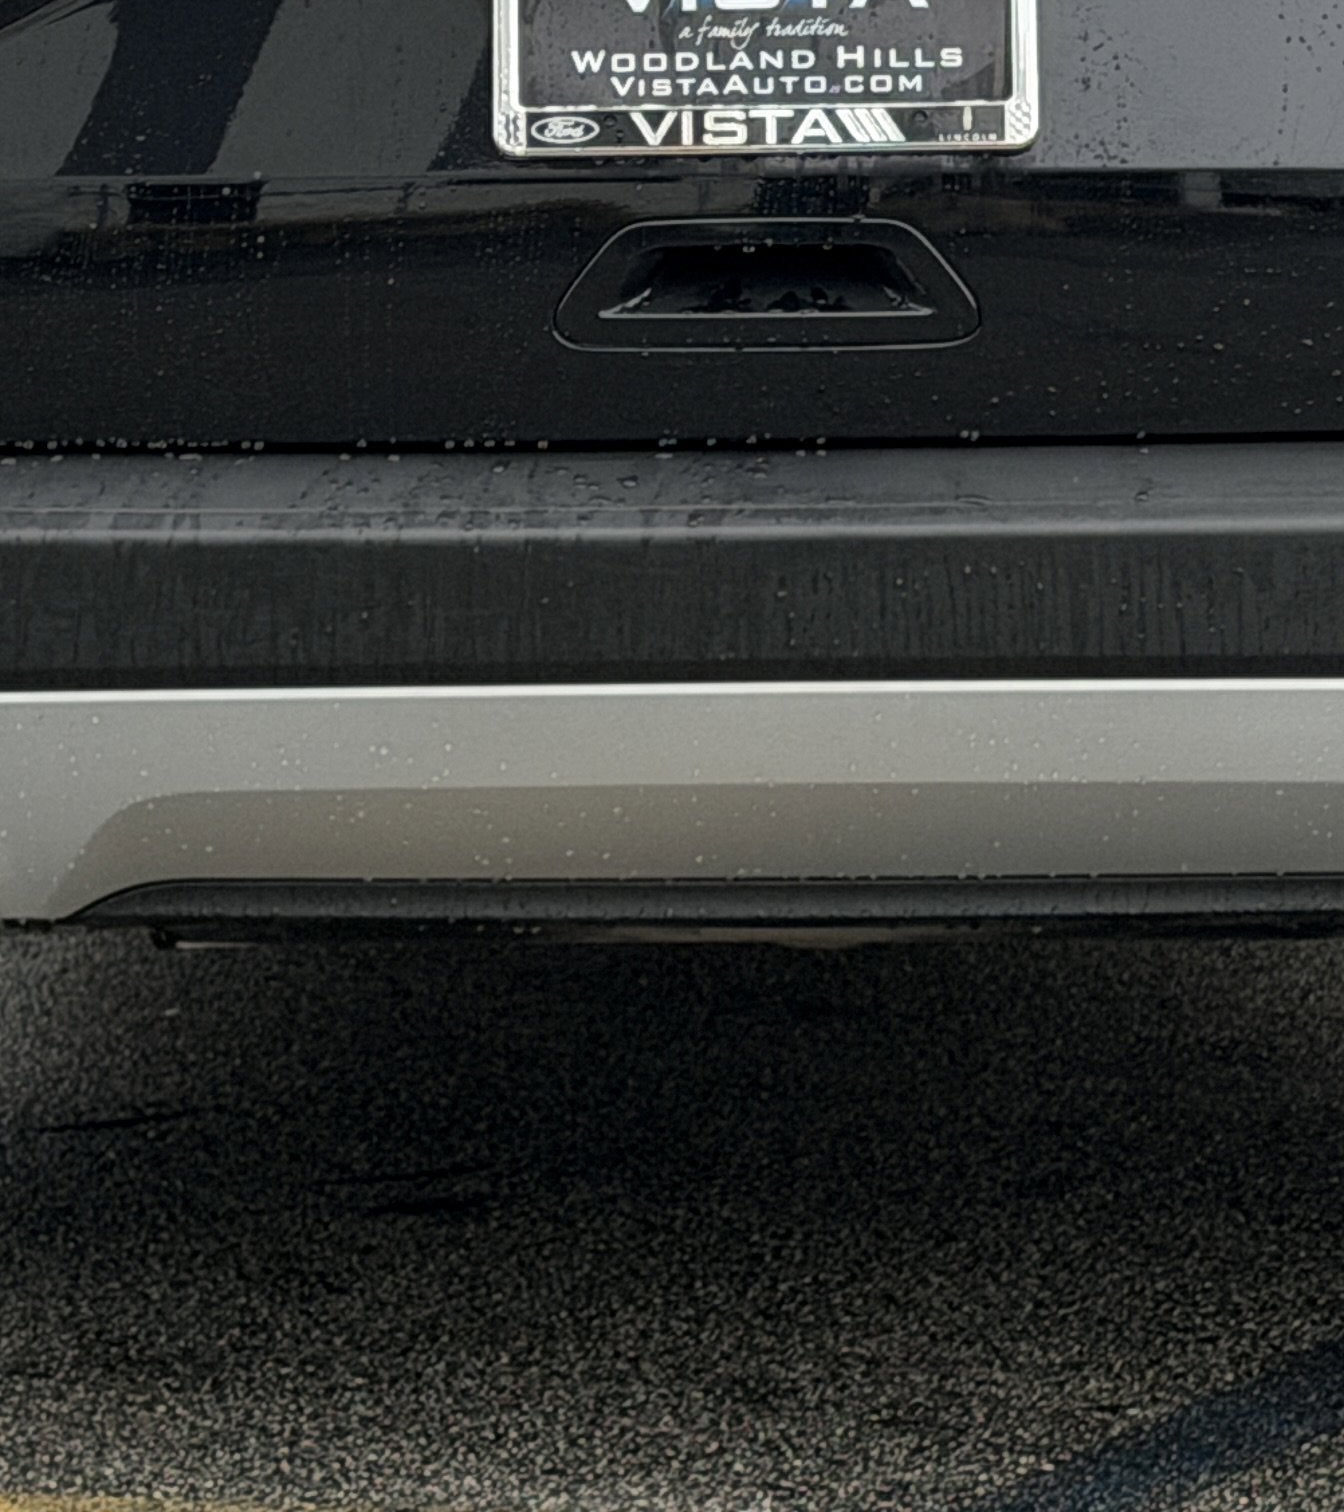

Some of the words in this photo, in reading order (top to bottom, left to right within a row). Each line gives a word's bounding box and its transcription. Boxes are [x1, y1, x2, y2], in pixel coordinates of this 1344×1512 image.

[678, 26, 694, 39] a
[695, 14, 761, 50] family
[765, 16, 849, 37] tradition
[571, 49, 817, 74] WOODLAND
[836, 45, 964, 69] HILLS
[628, 109, 843, 146] VISTA
